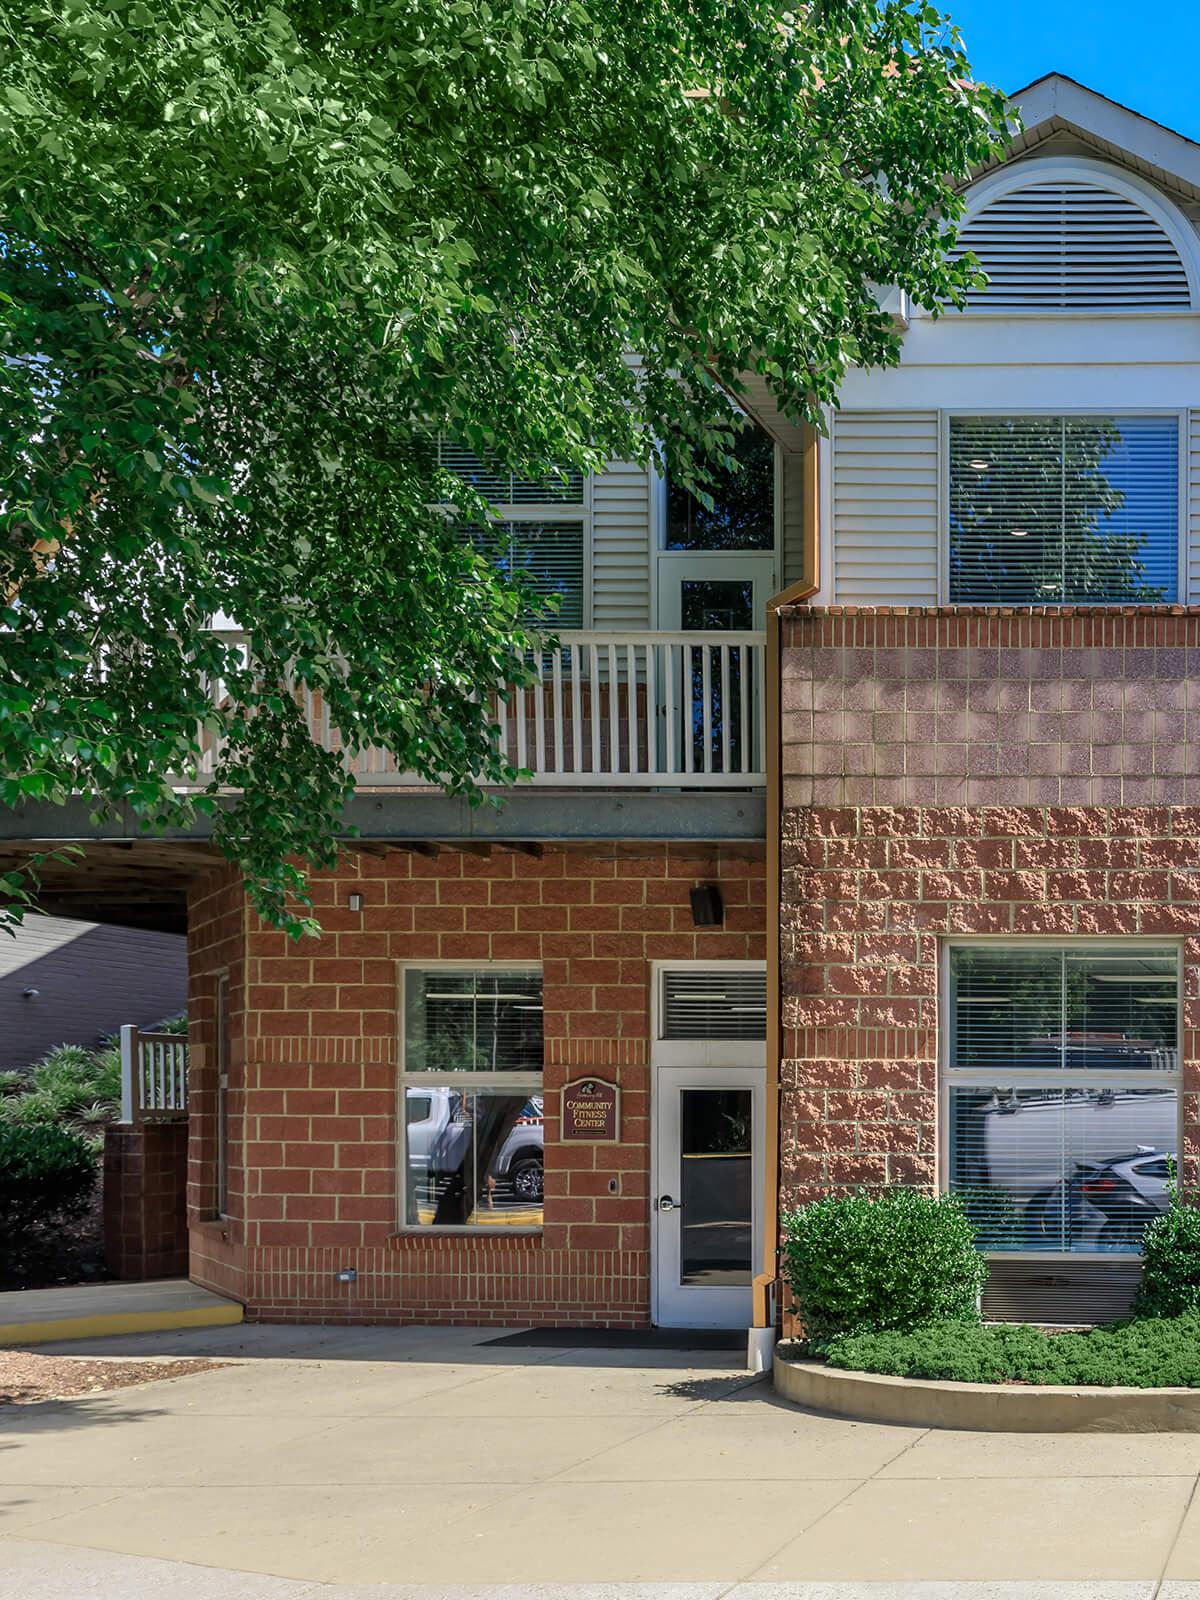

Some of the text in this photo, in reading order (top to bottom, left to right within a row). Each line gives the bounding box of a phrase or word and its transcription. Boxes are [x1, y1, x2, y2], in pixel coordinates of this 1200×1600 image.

[566, 1100, 612, 1110] COMMUNITY
[573, 1109, 607, 1119] FITNESS
[574, 1118, 605, 1127] CENTER
